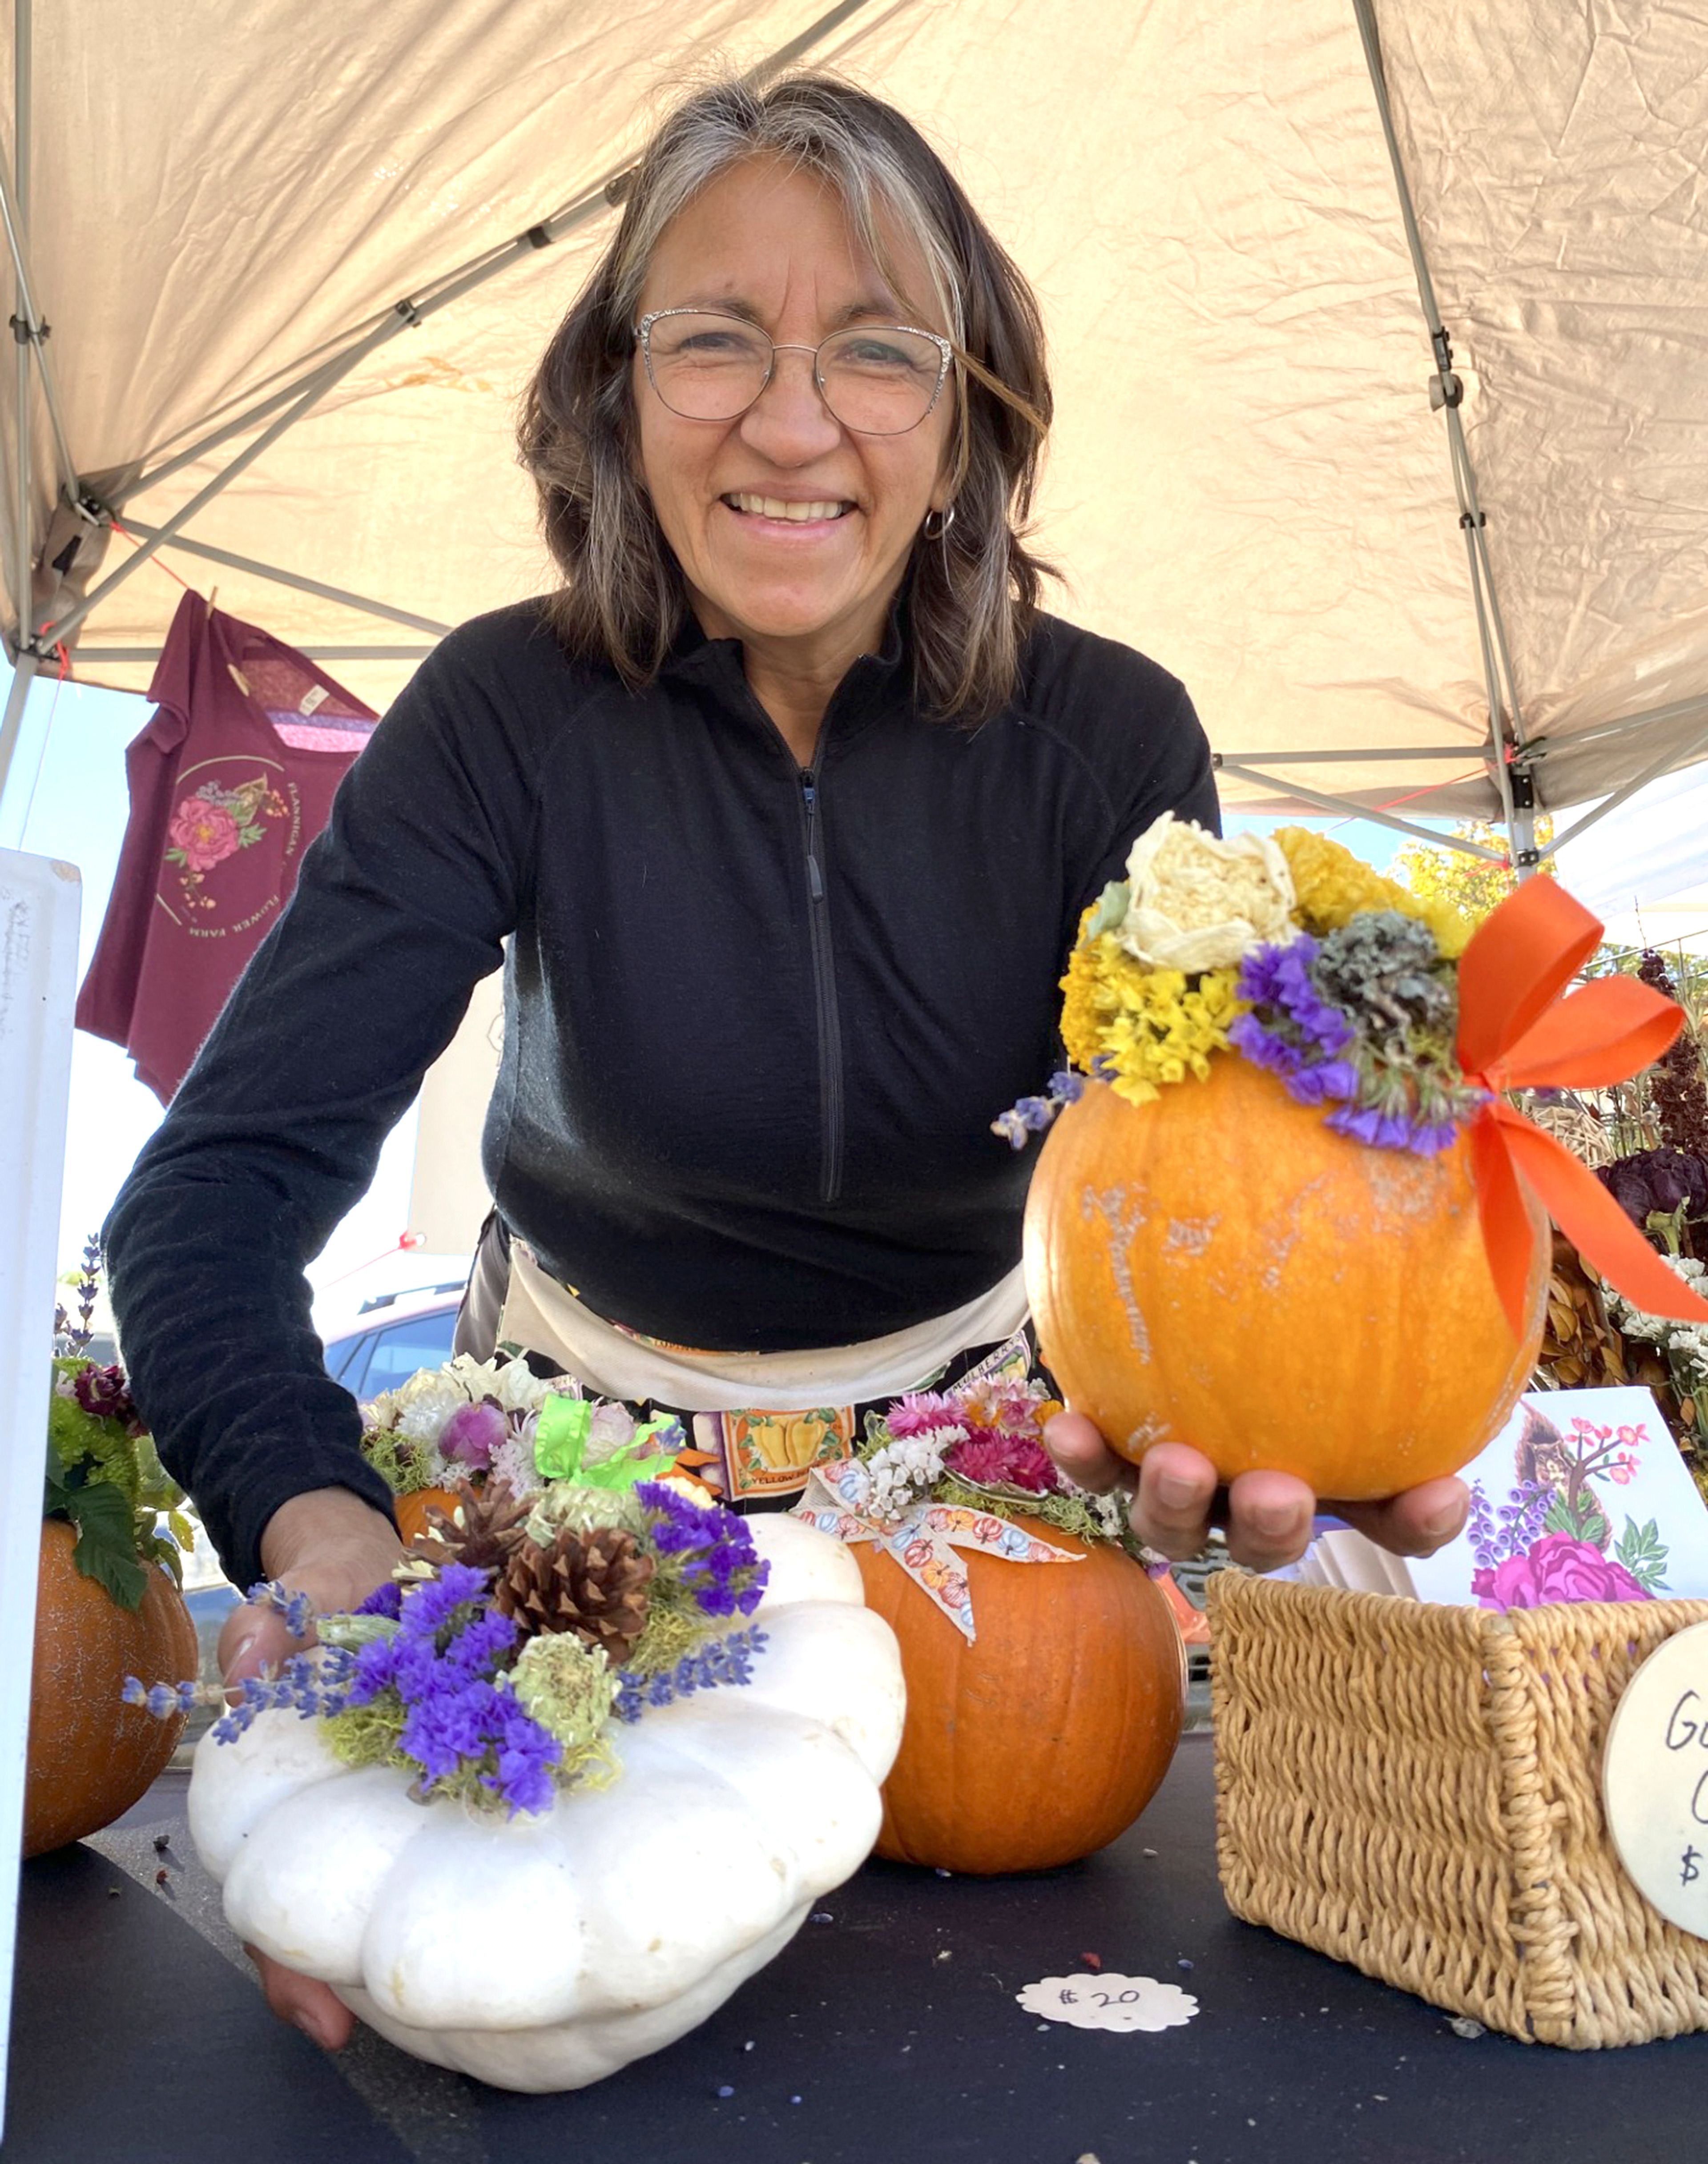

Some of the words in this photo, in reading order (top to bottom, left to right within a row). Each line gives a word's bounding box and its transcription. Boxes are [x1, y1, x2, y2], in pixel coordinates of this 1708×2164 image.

[285, 782, 301, 857] FLANNIGAN
[232, 894, 279, 932] FLOWER
[189, 927, 226, 937] FARM
[751, 1473, 794, 1484] YELLOW
